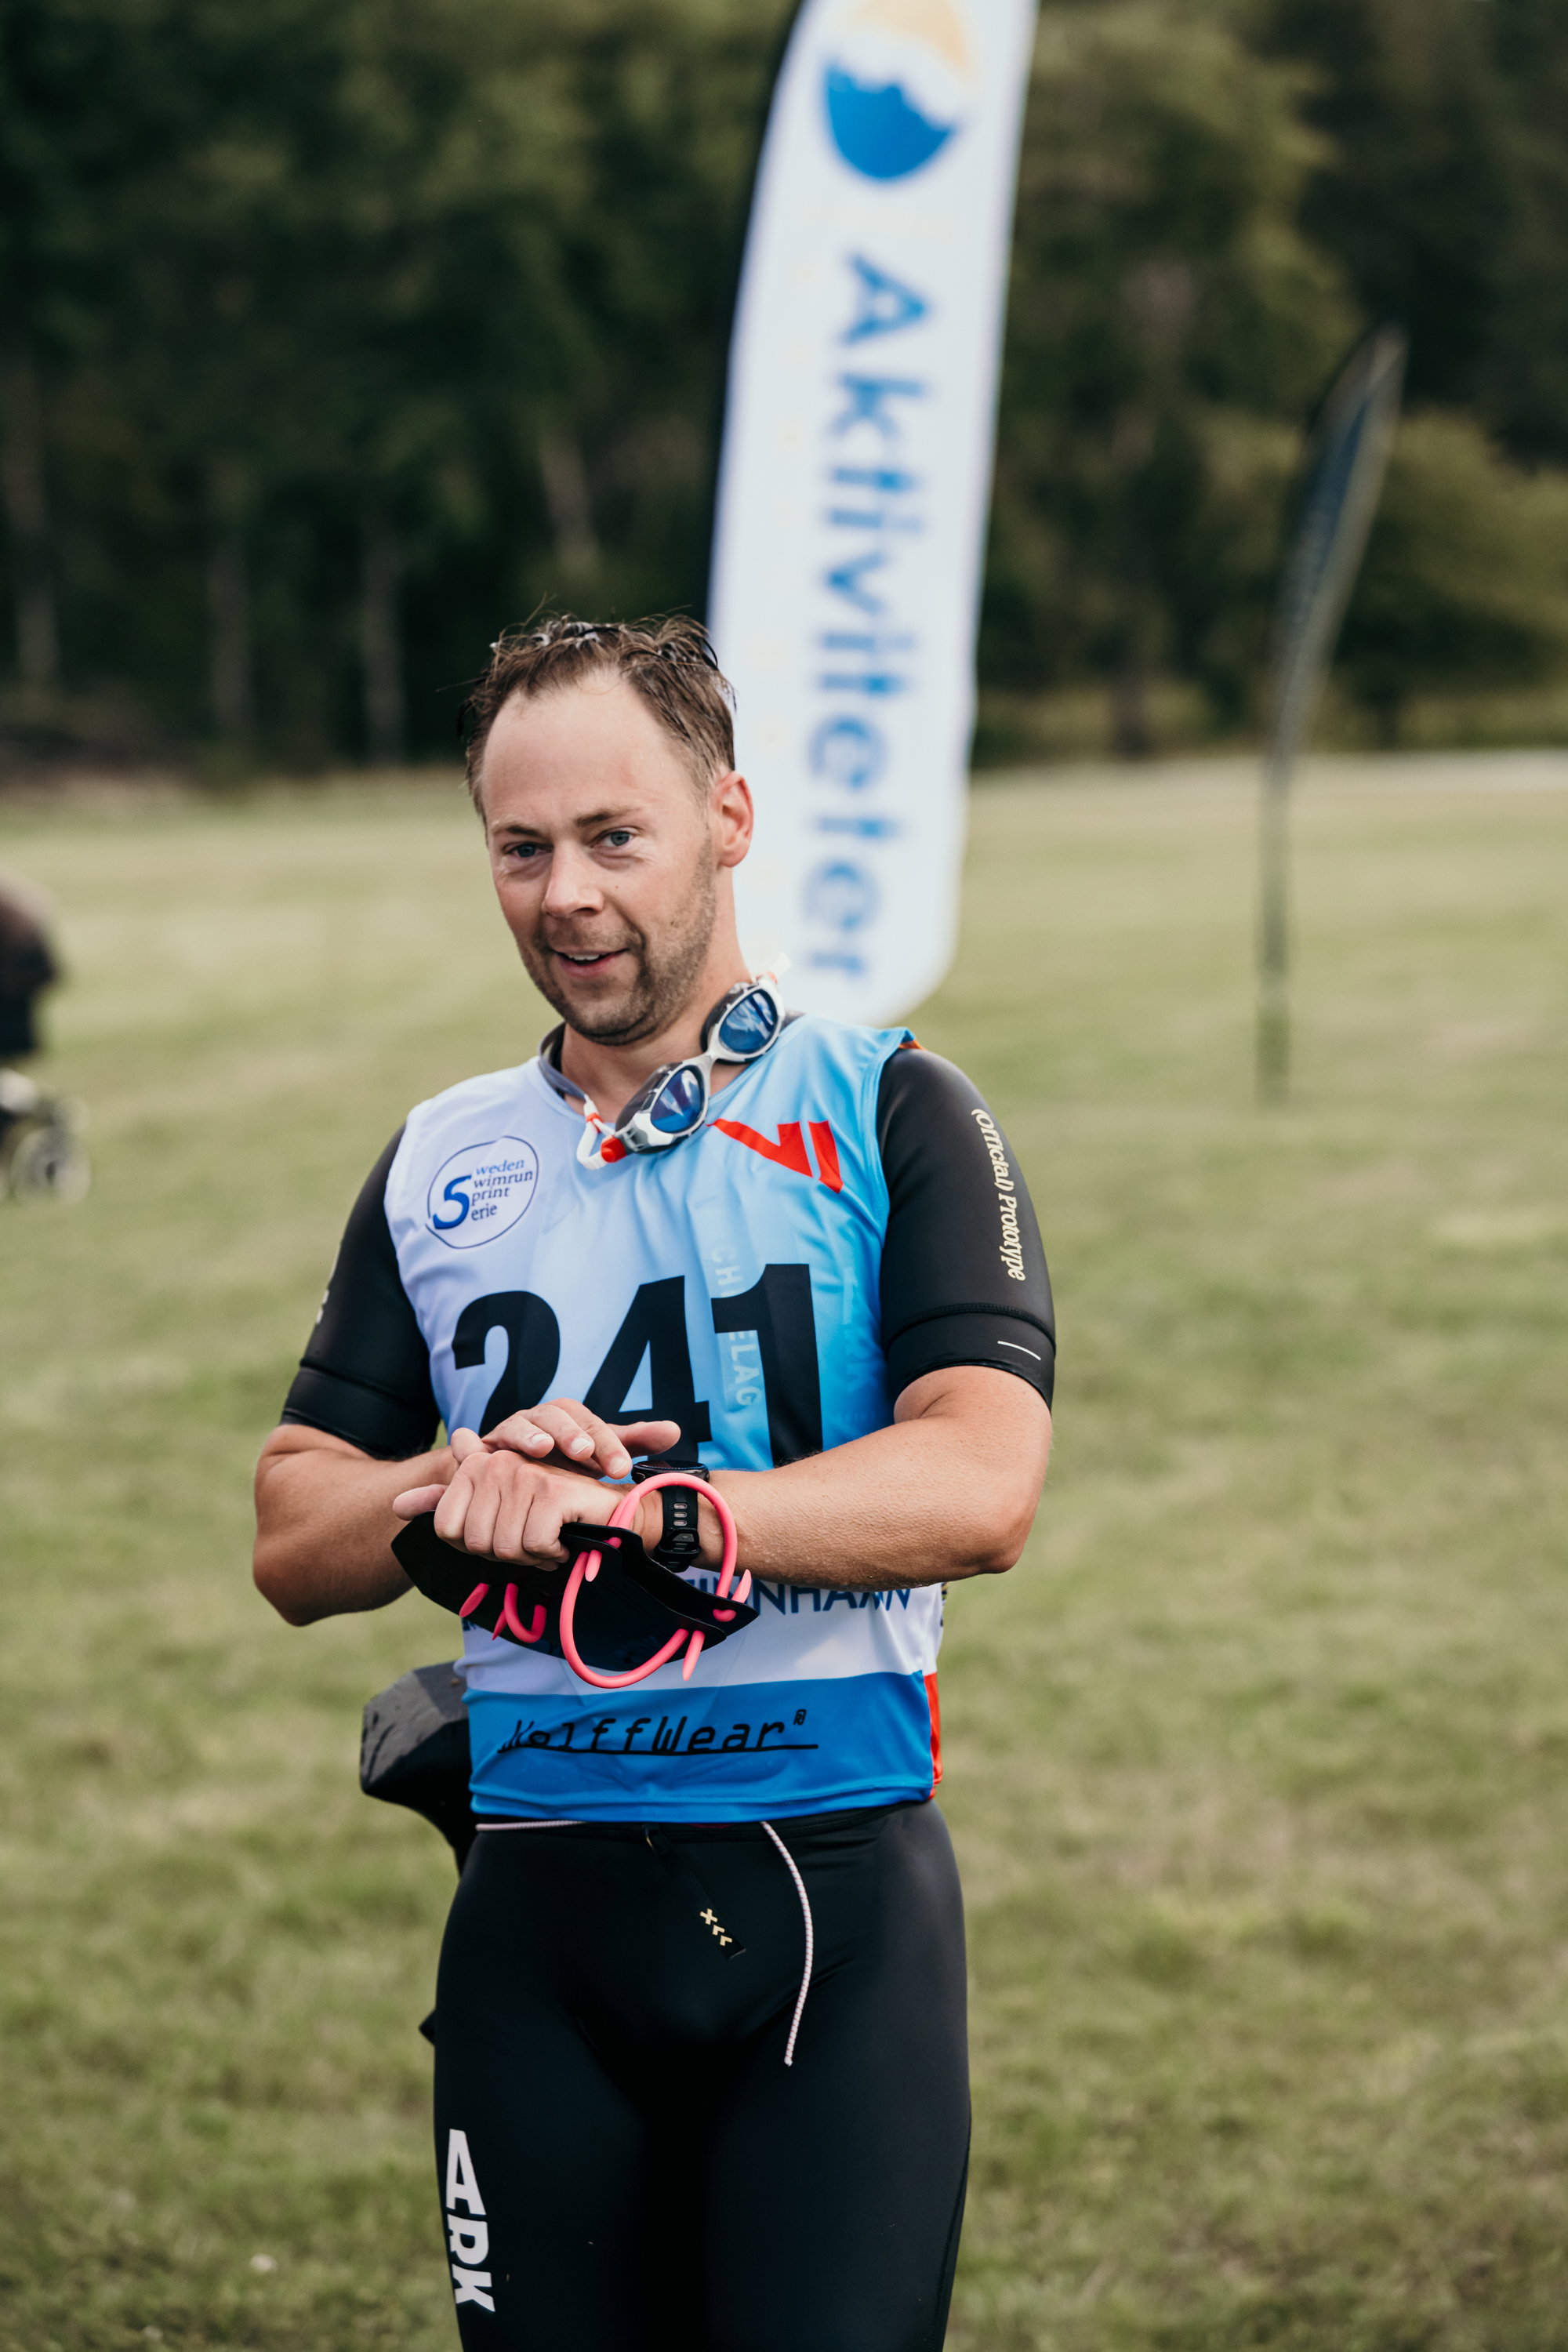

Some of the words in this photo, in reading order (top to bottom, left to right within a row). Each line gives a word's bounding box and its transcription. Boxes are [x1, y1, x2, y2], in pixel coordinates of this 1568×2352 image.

[801, 248, 931, 978] Aktiviteter
[470, 1203, 498, 1221] erie
[471, 1186, 510, 1207] print
[474, 1170, 533, 1189] wimrun
[971, 1108, 1014, 1192] (Official)
[997, 1192, 1026, 1282] Prototype
[452, 1264, 823, 1468] 241
[446, 2129, 495, 2313] ARK
